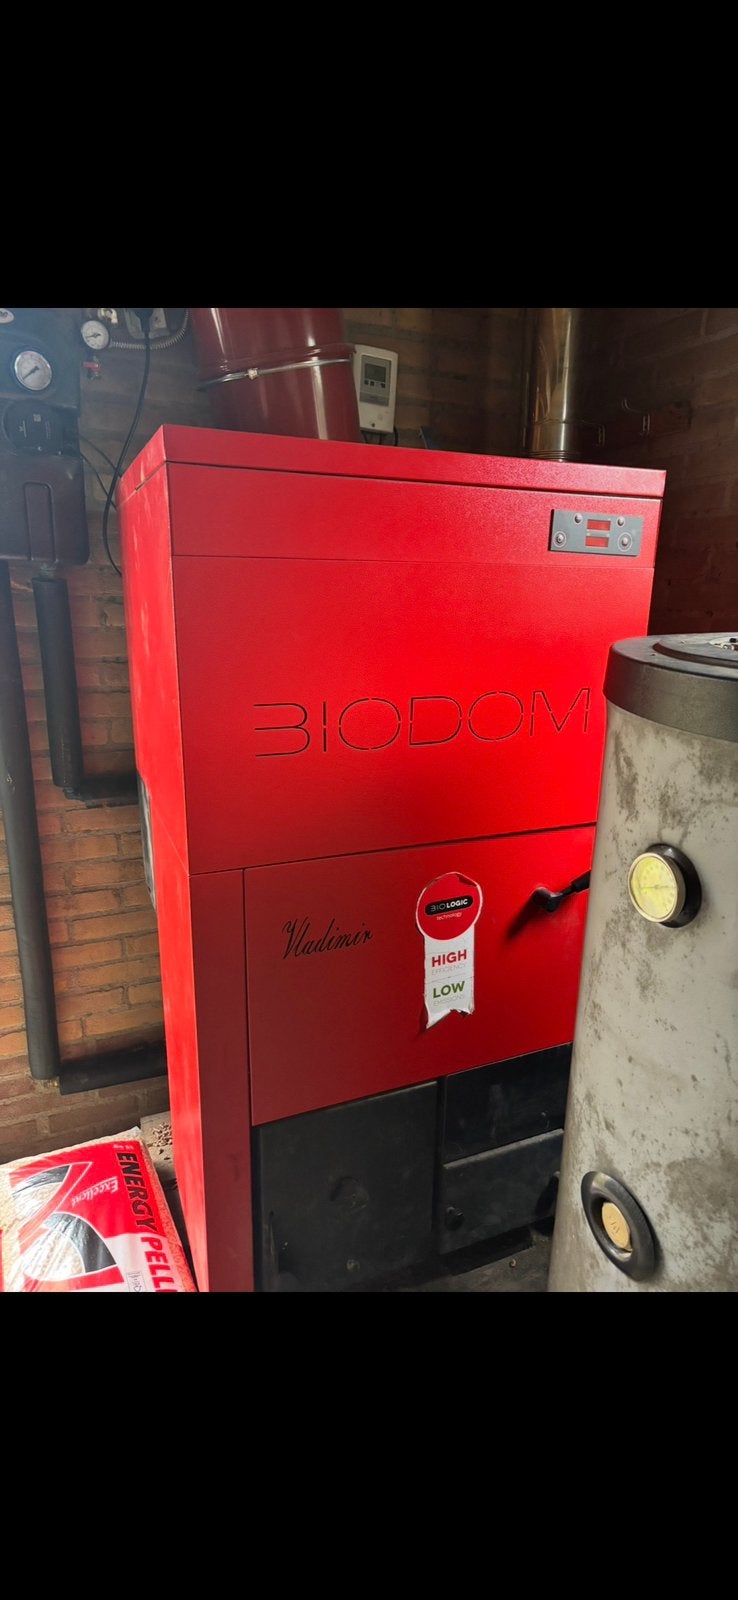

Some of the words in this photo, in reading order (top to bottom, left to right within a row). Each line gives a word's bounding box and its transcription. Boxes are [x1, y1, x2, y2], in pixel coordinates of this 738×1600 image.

[253, 687, 591, 757] BIODOM
[430, 898, 469, 912] BIOLOGIC
[436, 912, 463, 921] technology
[281, 916, 374, 960] Vladimir
[431, 949, 468, 968] HIGH
[431, 963, 467, 976] EFFICIENCY
[432, 981, 465, 999] LOW
[432, 994, 466, 1007] EMISSIONS
[71, 1176, 119, 1208] Excellent
[116, 1151, 158, 1232] ENERGY
[140, 1236, 179, 1293] PELL
